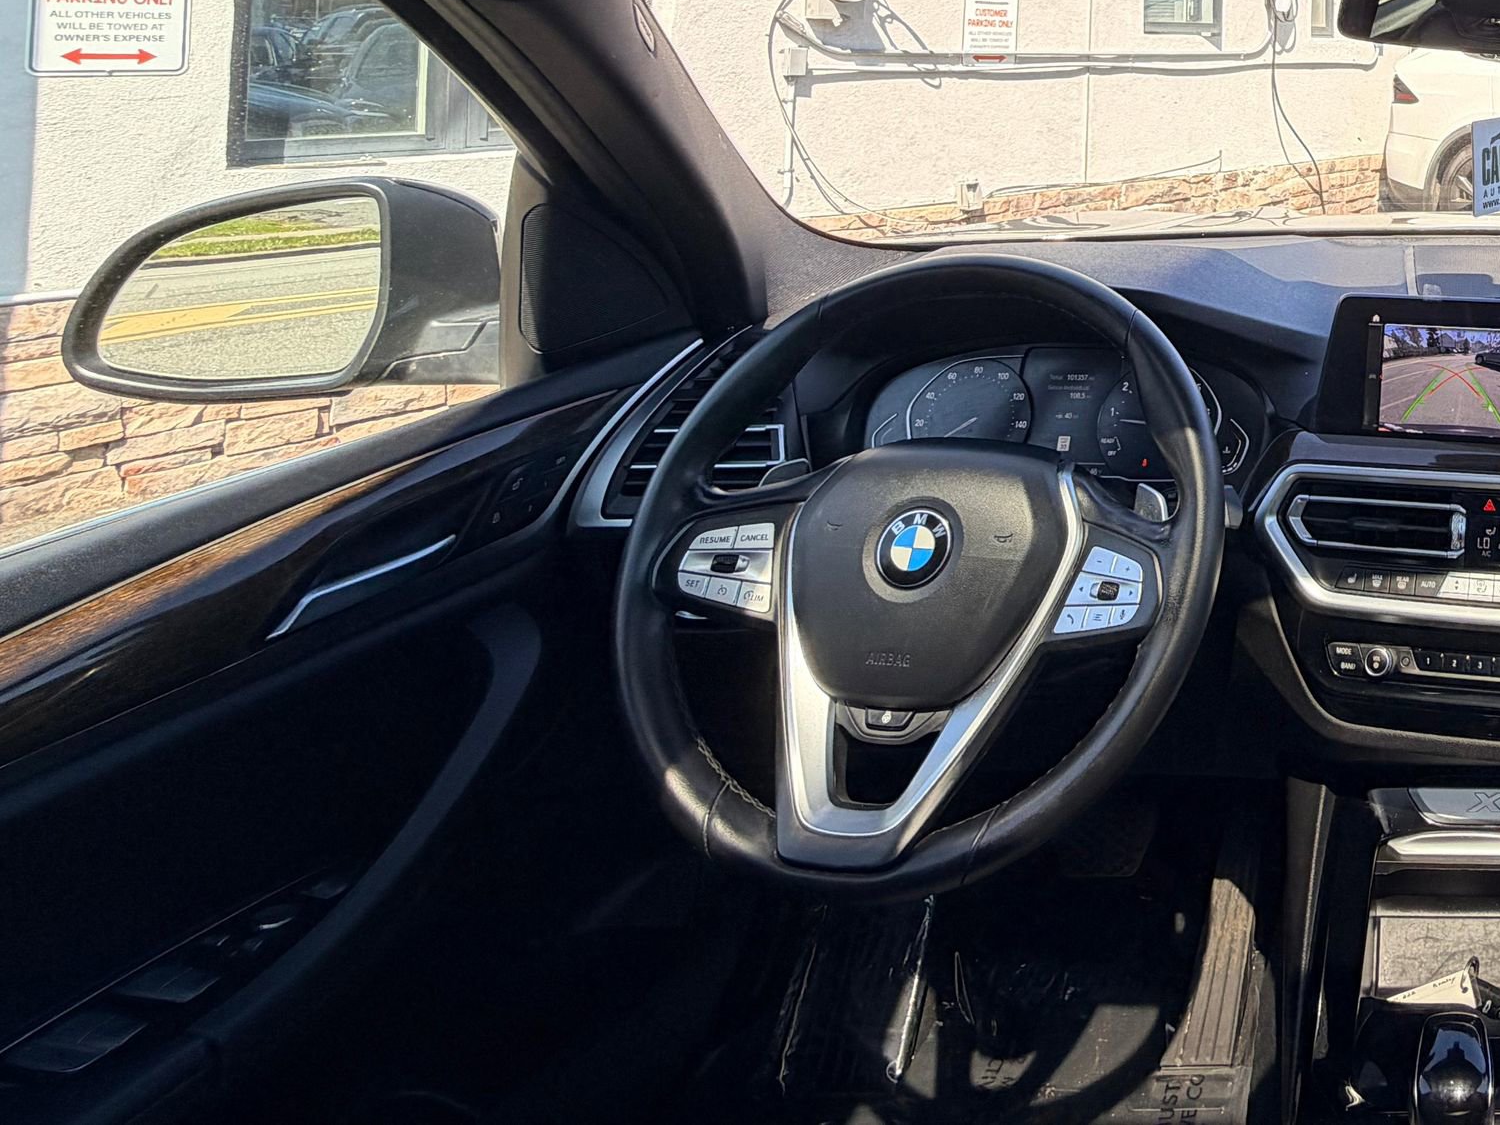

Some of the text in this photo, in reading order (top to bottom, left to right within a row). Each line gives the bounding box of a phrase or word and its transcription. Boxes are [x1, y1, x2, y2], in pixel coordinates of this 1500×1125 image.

[50, 10, 172, 20] ALL OTHER VEHICLES
[975, 8, 1008, 18] CUSTOMER
[56, 22, 164, 32] WILL BE TOWED AT
[968, 18, 1014, 28] PARKING ONLY
[54, 34, 166, 43] OWNER'S EXPENSE
[1122, 382, 1129, 392] 2
[1012, 392, 1025, 400] 120
[914, 419, 925, 427] 20
[1014, 420, 1028, 428] 140
[890, 512, 947, 539] BMW
[700, 536, 732, 544] RESUME
[740, 534, 768, 542] CANCEL
[684, 579, 701, 588] SET
[1420, 580, 1436, 588] AUTO
[1336, 646, 1352, 656] MODE
[865, 652, 911, 668] AIRBAG
[1340, 662, 1357, 670] BAND
